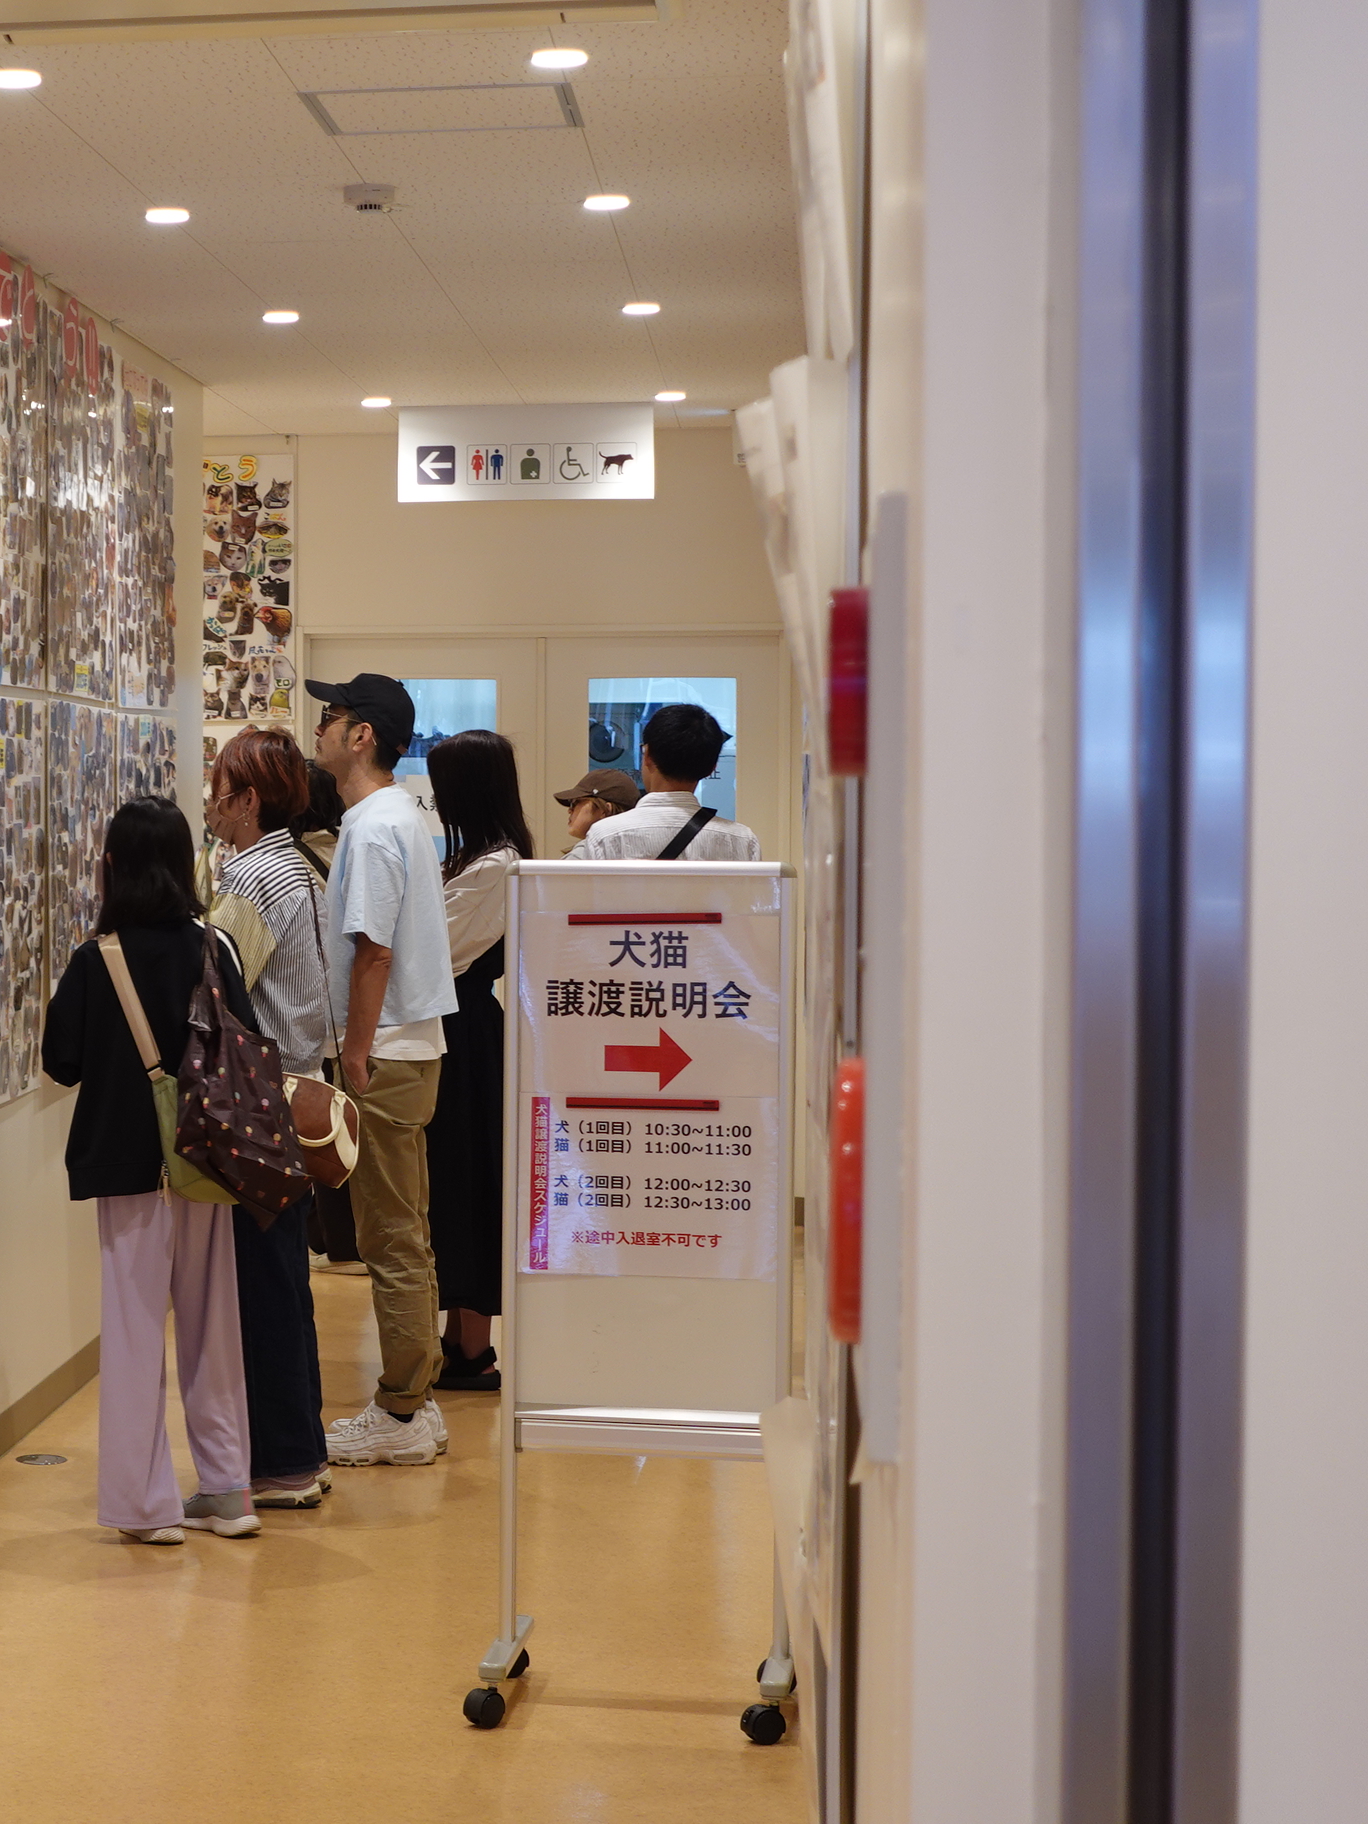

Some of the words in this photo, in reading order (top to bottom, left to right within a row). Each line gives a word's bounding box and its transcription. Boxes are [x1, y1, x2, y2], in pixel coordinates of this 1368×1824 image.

[608, 929, 689, 969] 犬猫
[545, 979, 752, 1020] 譲渡説明会
[645, 1123, 752, 1138] 10:30~11:00
[645, 1141, 752, 1156] 11:00~11:30
[532, 1103, 549, 1264] 犬猫譲渡説明会スケジュール
[644, 1178, 751, 1193] 12:00~12:30
[644, 1196, 751, 1211] 12:30~13:00
[571, 1231, 723, 1248] ※途中入退室不可です
